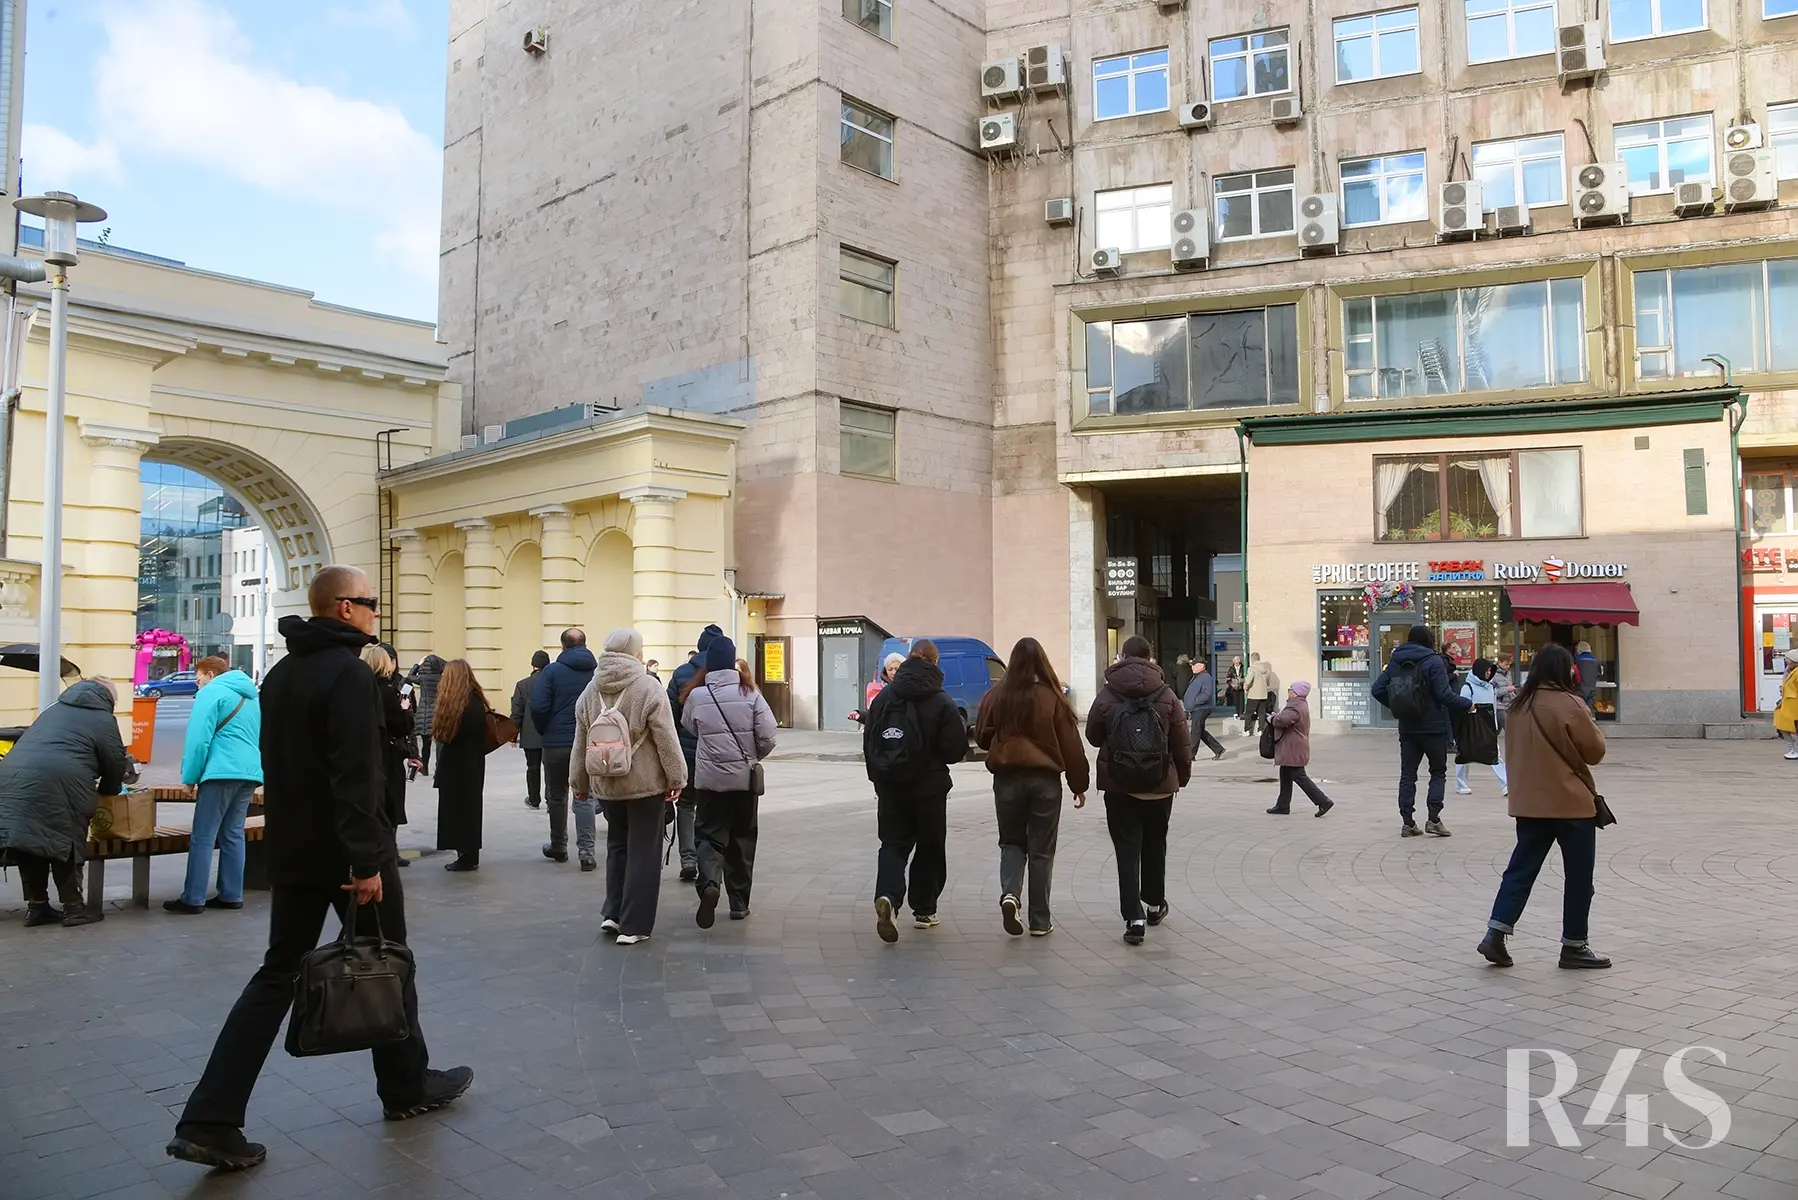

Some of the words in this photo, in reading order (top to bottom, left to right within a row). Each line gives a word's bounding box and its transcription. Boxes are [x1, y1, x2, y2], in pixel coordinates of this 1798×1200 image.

[1312, 564, 1320, 583] ONE
[1321, 563, 1364, 583] PRICE
[1367, 562, 1419, 582] COFFEE
[1428, 560, 1484, 572] ТАБАК
[1493, 561, 1542, 583] Ruby
[1566, 561, 1628, 578] Doner
[1428, 571, 1485, 581] НАПИТКИ
